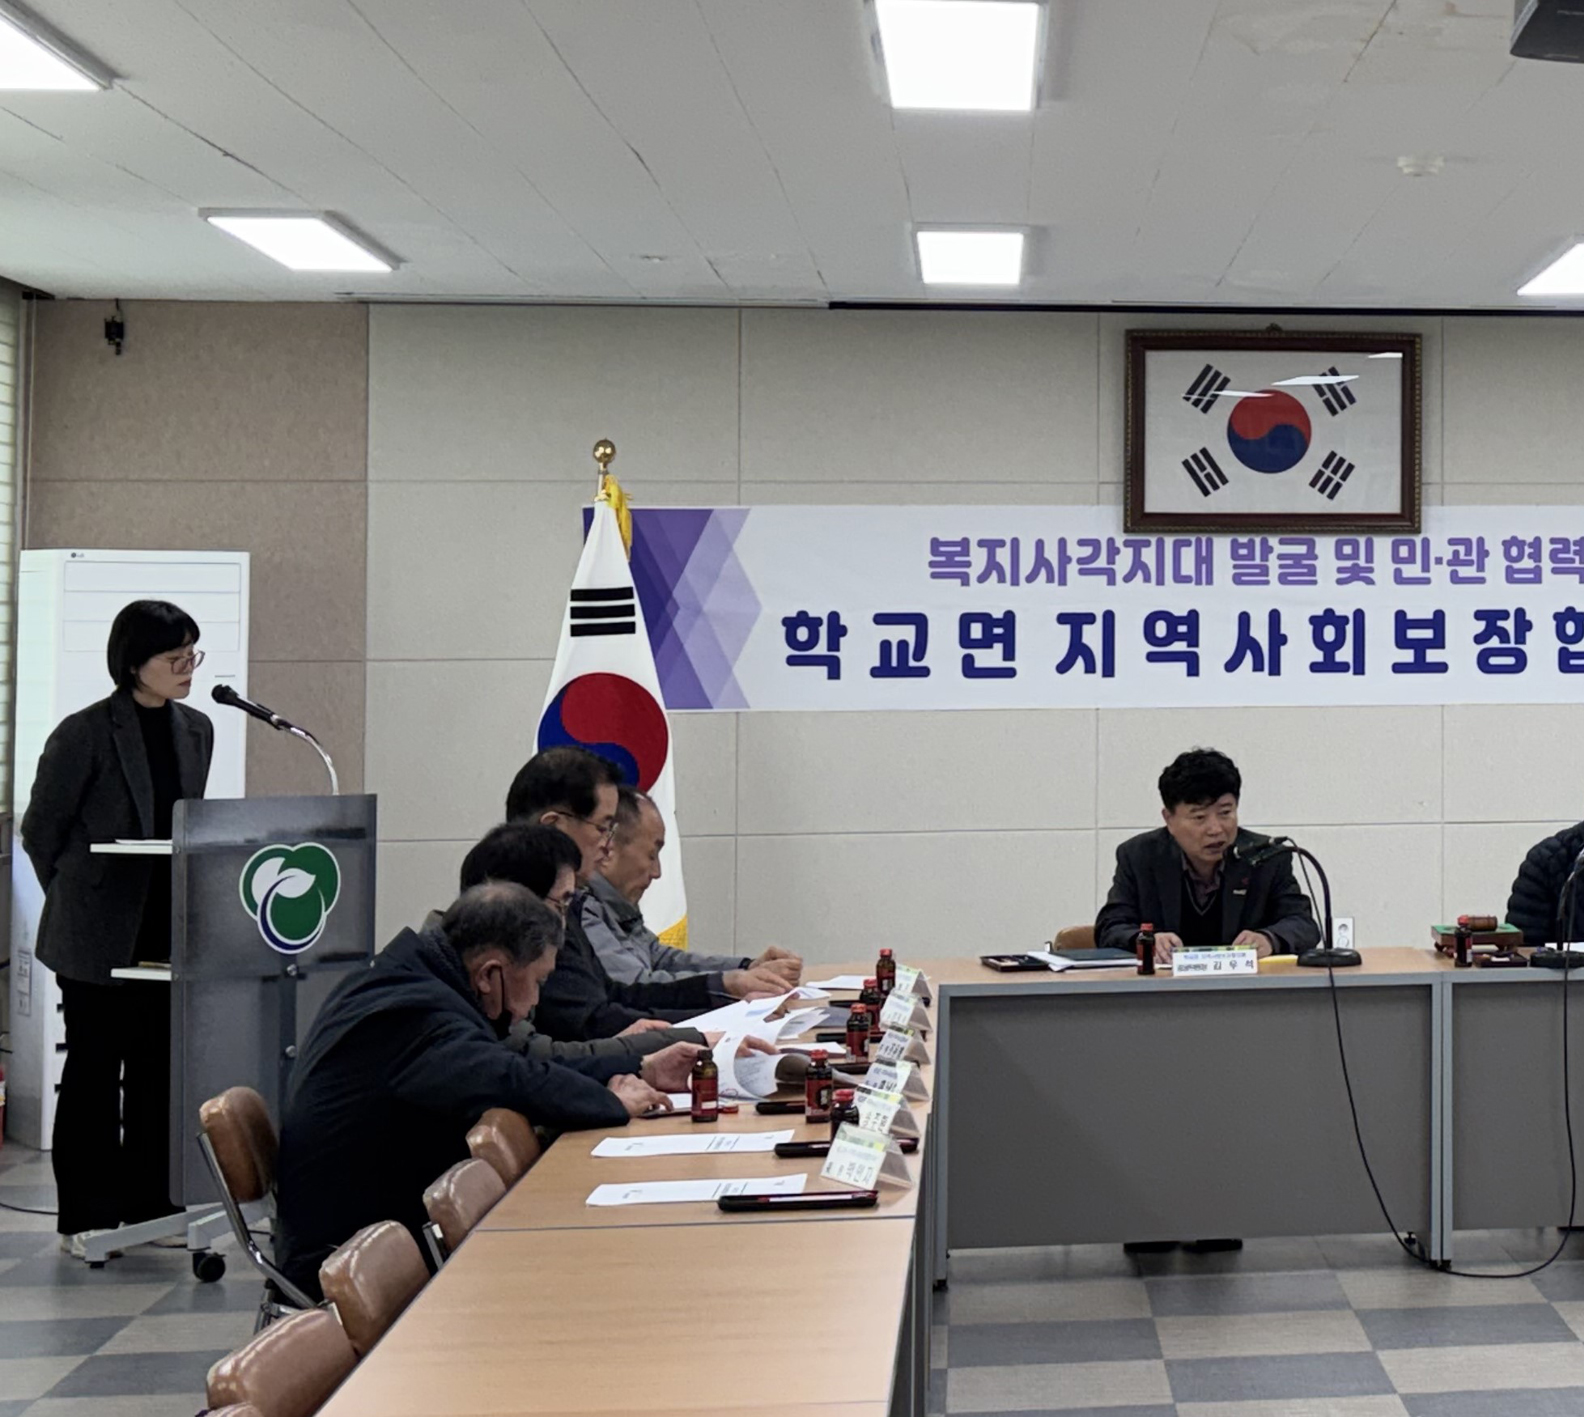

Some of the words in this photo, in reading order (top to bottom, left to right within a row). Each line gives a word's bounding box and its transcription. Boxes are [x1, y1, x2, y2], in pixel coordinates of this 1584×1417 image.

[927, 536, 1213, 588] 복지사각지대
[1231, 536, 1319, 586] 발굴
[1335, 536, 1376, 586] 및
[781, 609, 1018, 681] 학교면
